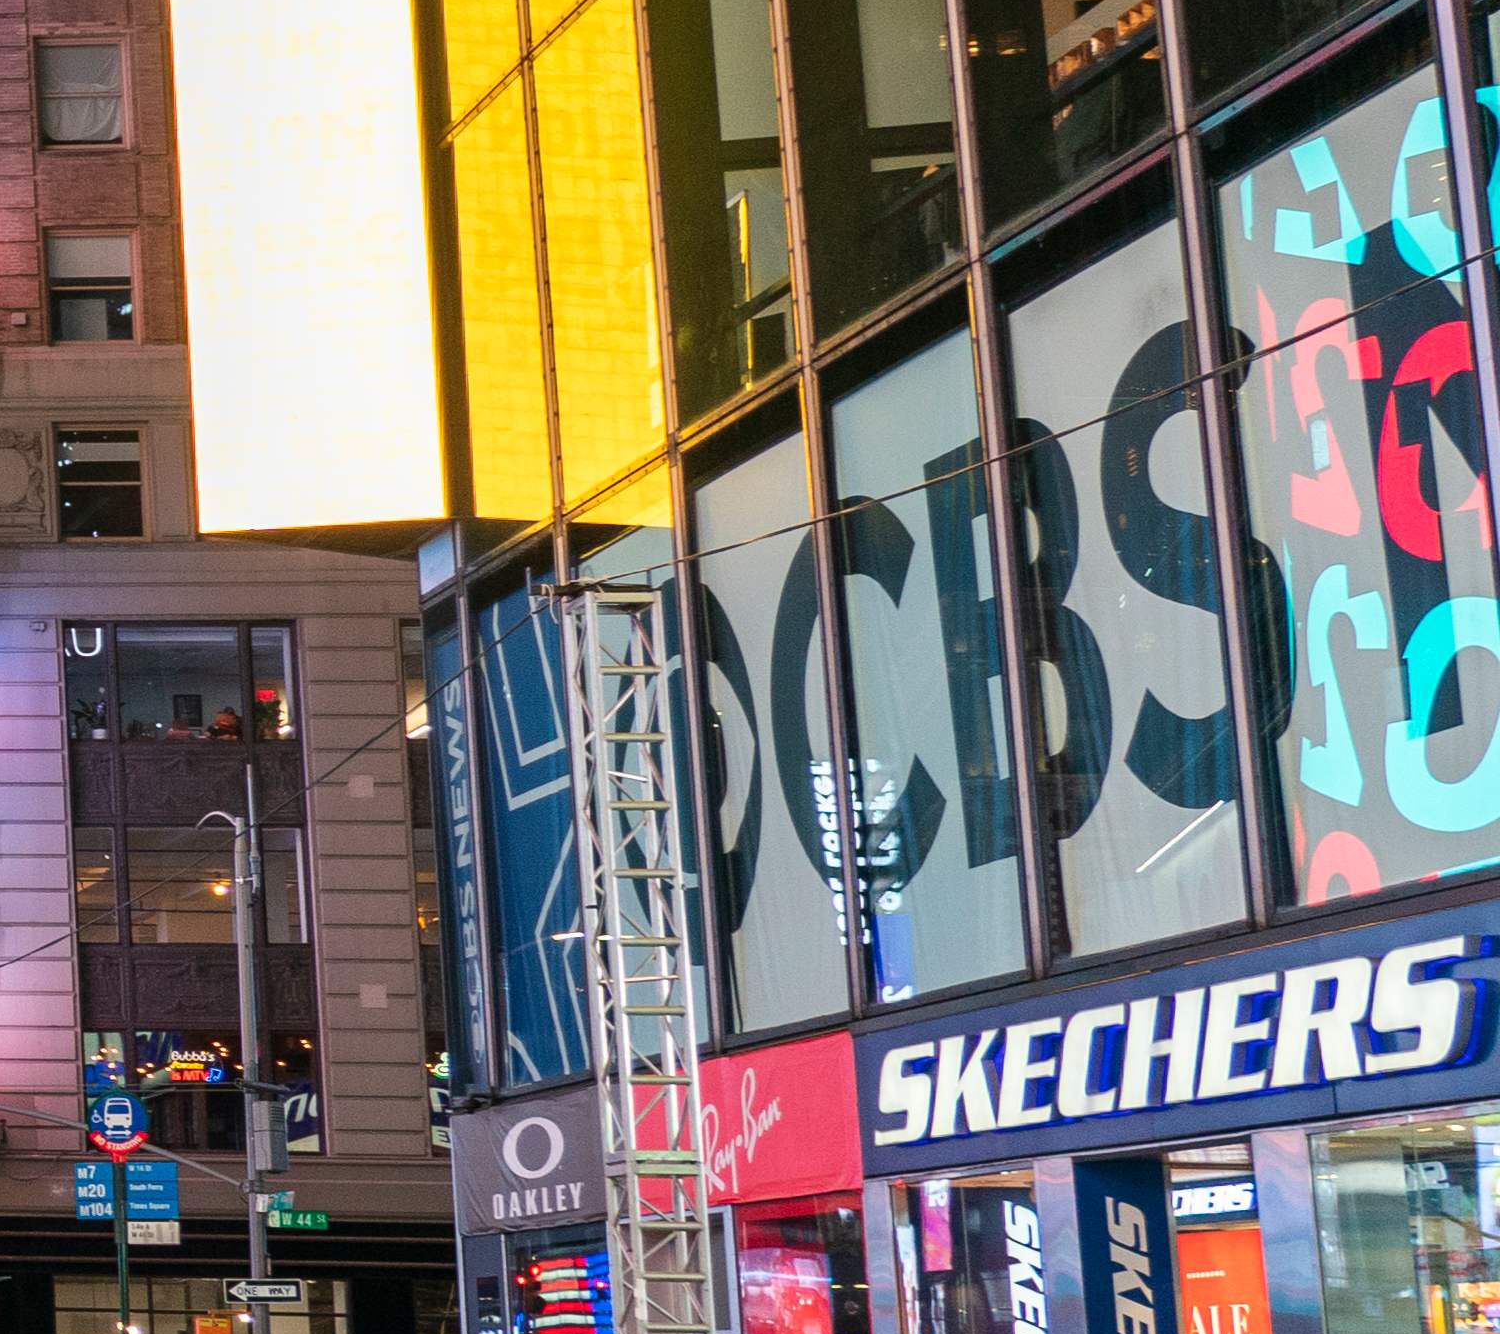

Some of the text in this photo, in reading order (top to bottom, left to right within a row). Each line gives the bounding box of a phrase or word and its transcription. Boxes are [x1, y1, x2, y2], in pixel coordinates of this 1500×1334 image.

[770, 319, 1295, 893] CBS
[445, 677, 472, 869] NEWS
[875, 935, 1470, 1147] SKECHERS
[78, 1166, 97, 1180] M7
[78, 1184, 106, 1199] M20
[493, 1182, 584, 1220] OAKLEY
[80, 1203, 114, 1217] M104
[282, 1213, 311, 1226] W 44
[237, 1286, 291, 1296] ONE WAY
